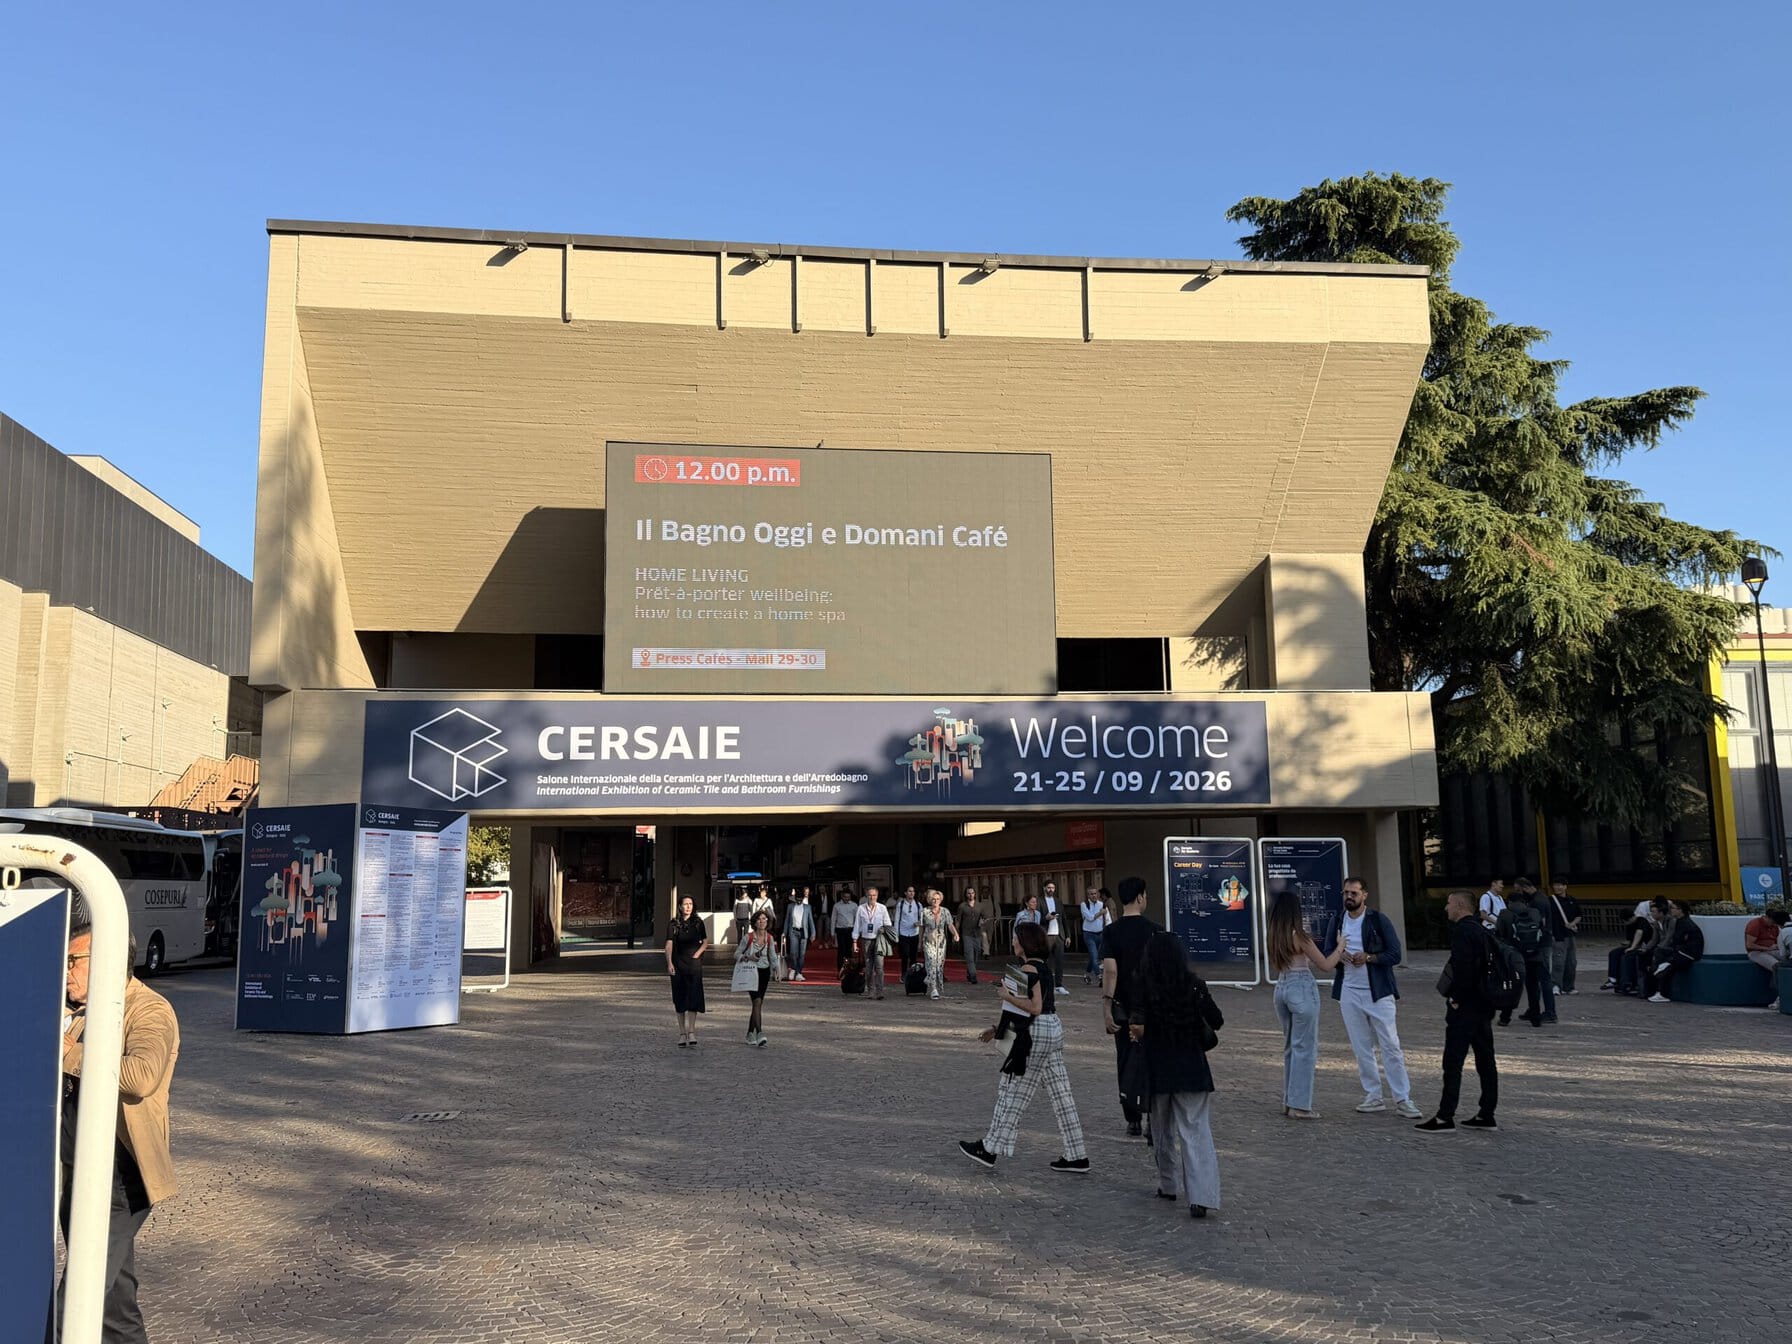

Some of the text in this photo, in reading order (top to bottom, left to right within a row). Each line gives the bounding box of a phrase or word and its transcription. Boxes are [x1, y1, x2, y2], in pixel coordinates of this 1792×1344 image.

[676, 461, 796, 485] 12.00 p.m.
[636, 519, 1009, 548] Il Bagno Oggi e Domani Café
[635, 567, 750, 583] HOME LIVING
[635, 585, 834, 604] Prêt-à-porter wellbeing:
[634, 605, 847, 624] how to create a home spa
[656, 653, 693, 665] Press
[697, 652, 733, 665] Cafés
[746, 653, 774, 665] Mall
[778, 653, 817, 666] 29-30
[537, 725, 741, 761] CERSAIE
[1009, 715, 1229, 759] Welcome
[537, 772, 868, 785] Salone Internazionale della Ceramica per l'Architettura e dell'Arredobagno
[1013, 770, 1232, 794] 21-25 / 09 / 2026
[537, 784, 841, 795] International Exhibition of Ceramic Tile and Bathroom Furnishings
[377, 812, 400, 820] CERSAIE
[266, 824, 291, 832] CERSAIE
[144, 889, 181, 905] COSEPURI
